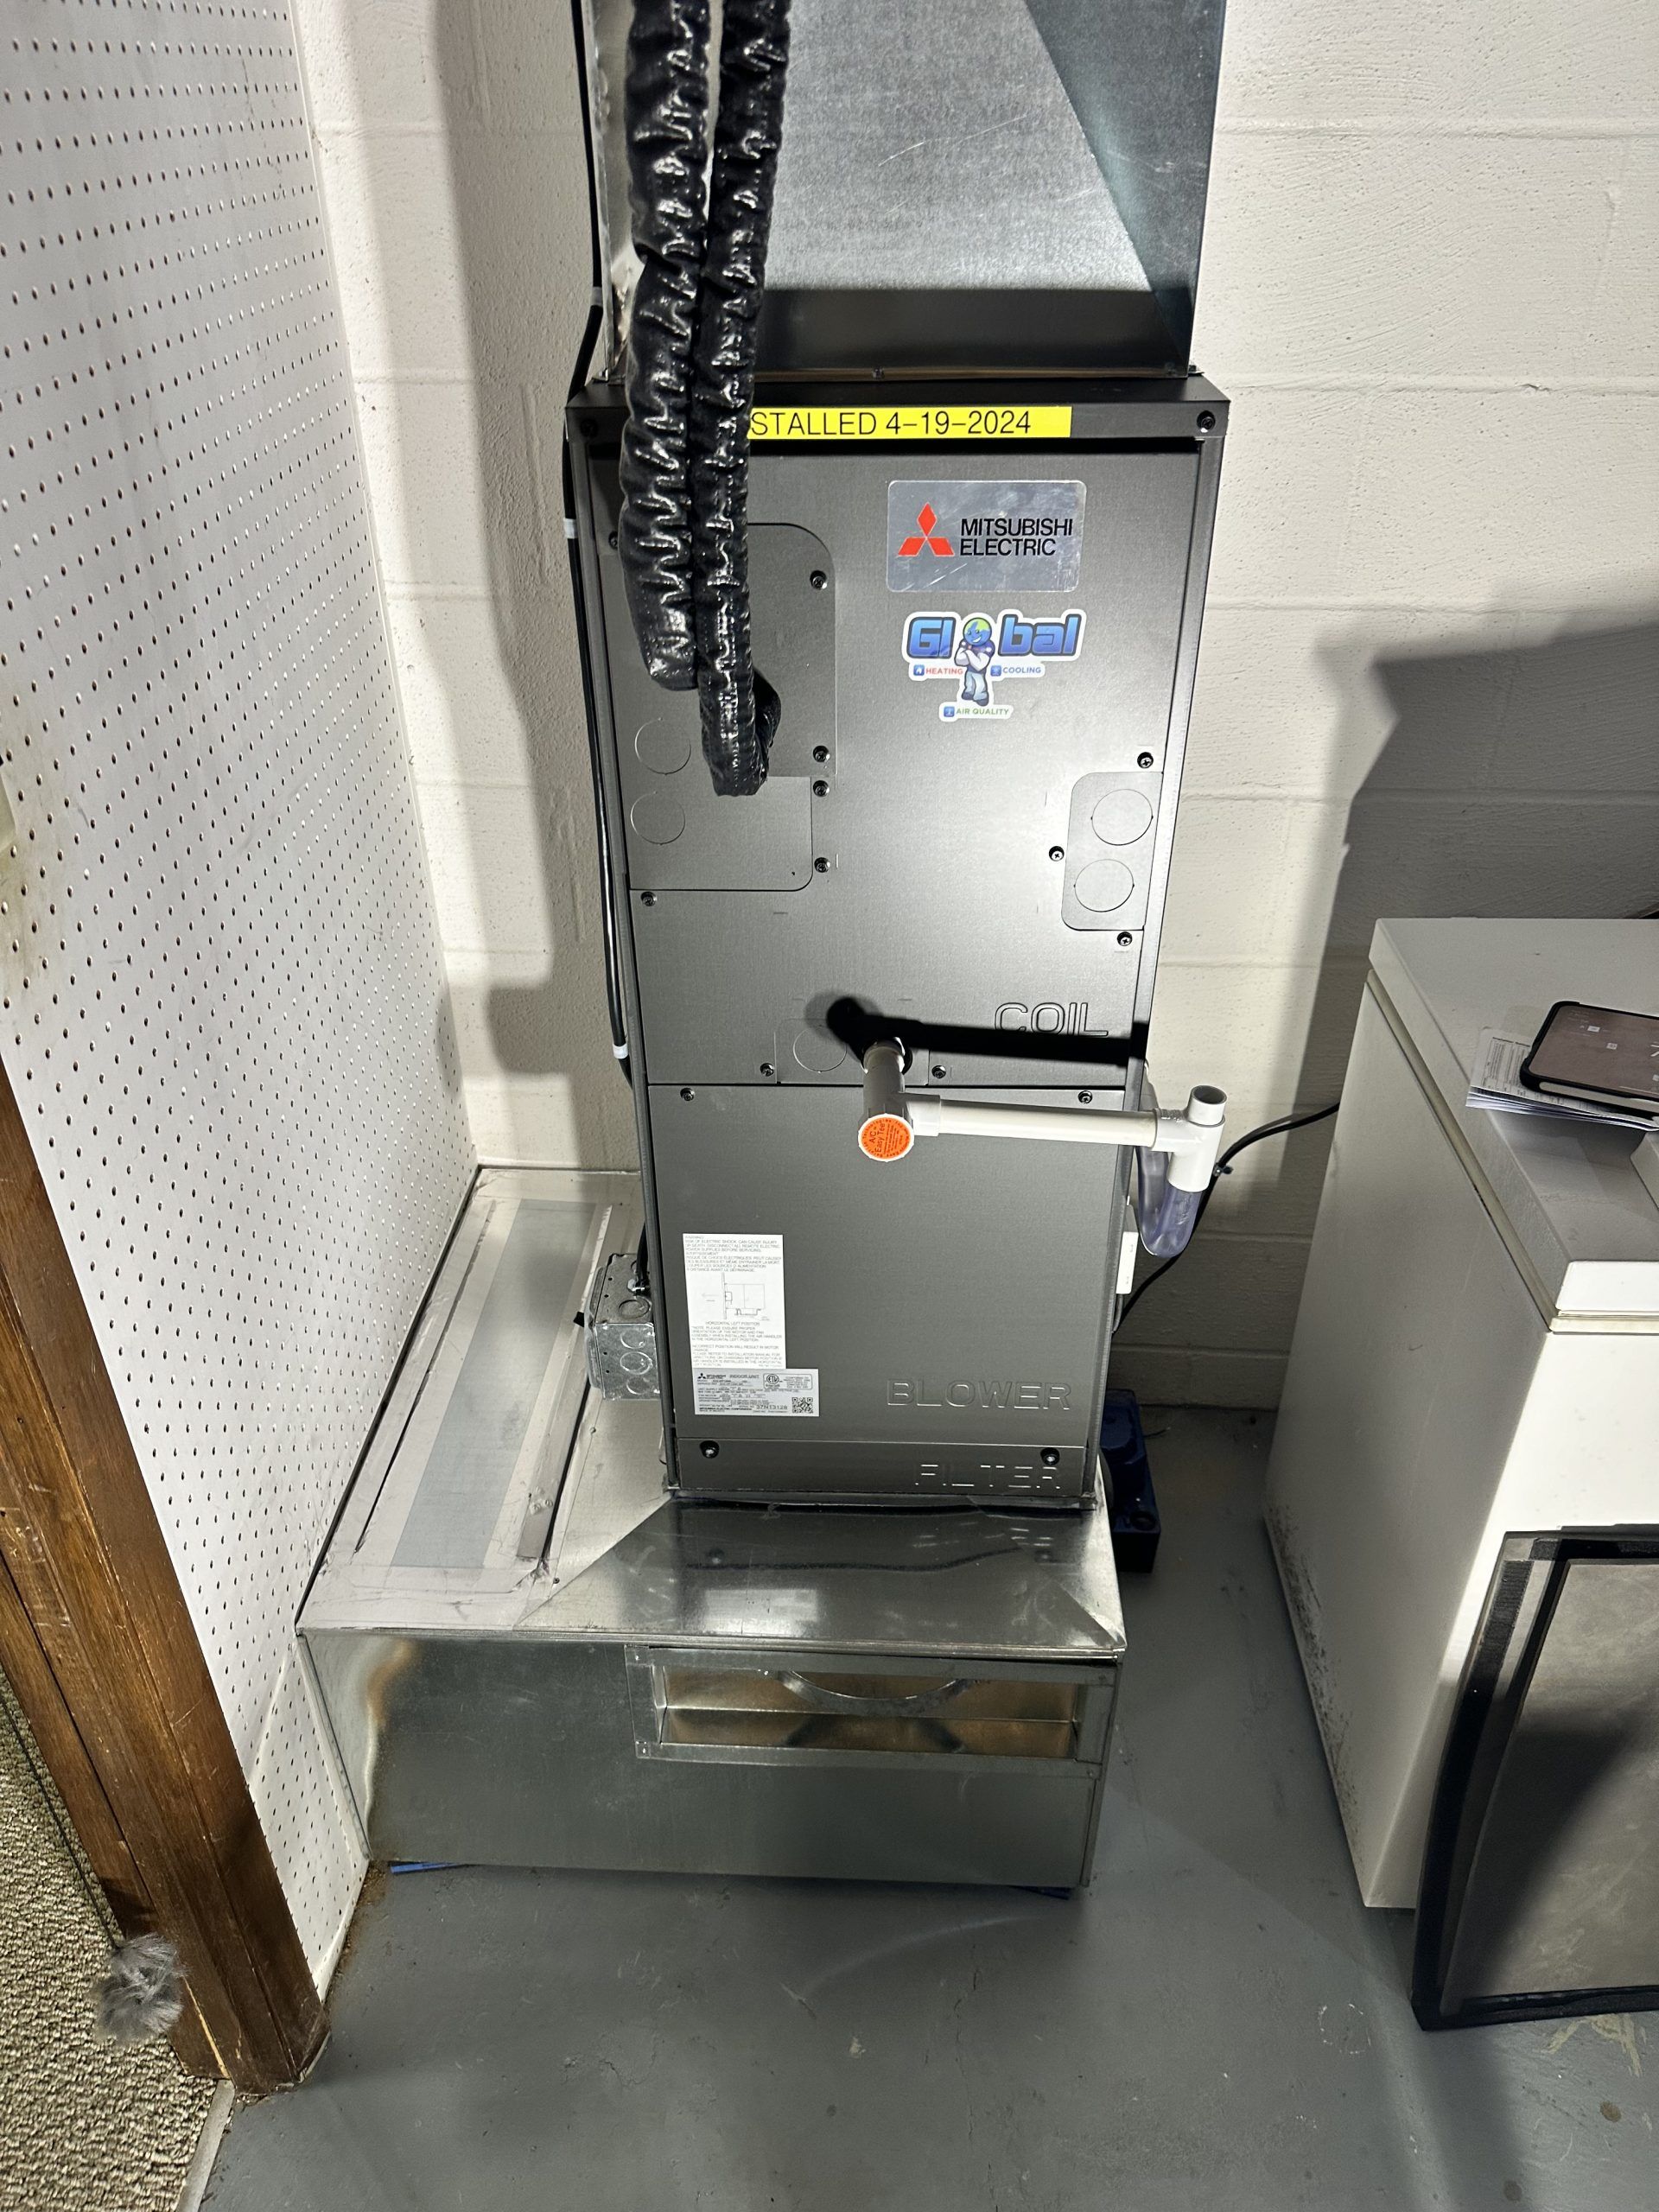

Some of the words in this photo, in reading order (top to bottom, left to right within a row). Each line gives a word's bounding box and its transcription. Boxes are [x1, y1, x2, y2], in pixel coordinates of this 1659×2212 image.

[886, 410, 1032, 435] 4-19-2024
[961, 518, 1073, 537] MITSUBISHI
[960, 538, 1057, 556] ELECTRIC
[925, 667, 963, 676] HEATING
[972, 708, 1009, 716] QUALITY
[995, 1002, 1109, 1037] COIL
[877, 1123, 886, 1135] Tee
[887, 1379, 1071, 1410] BLOWER
[914, 1463, 1063, 1490] FILTER
